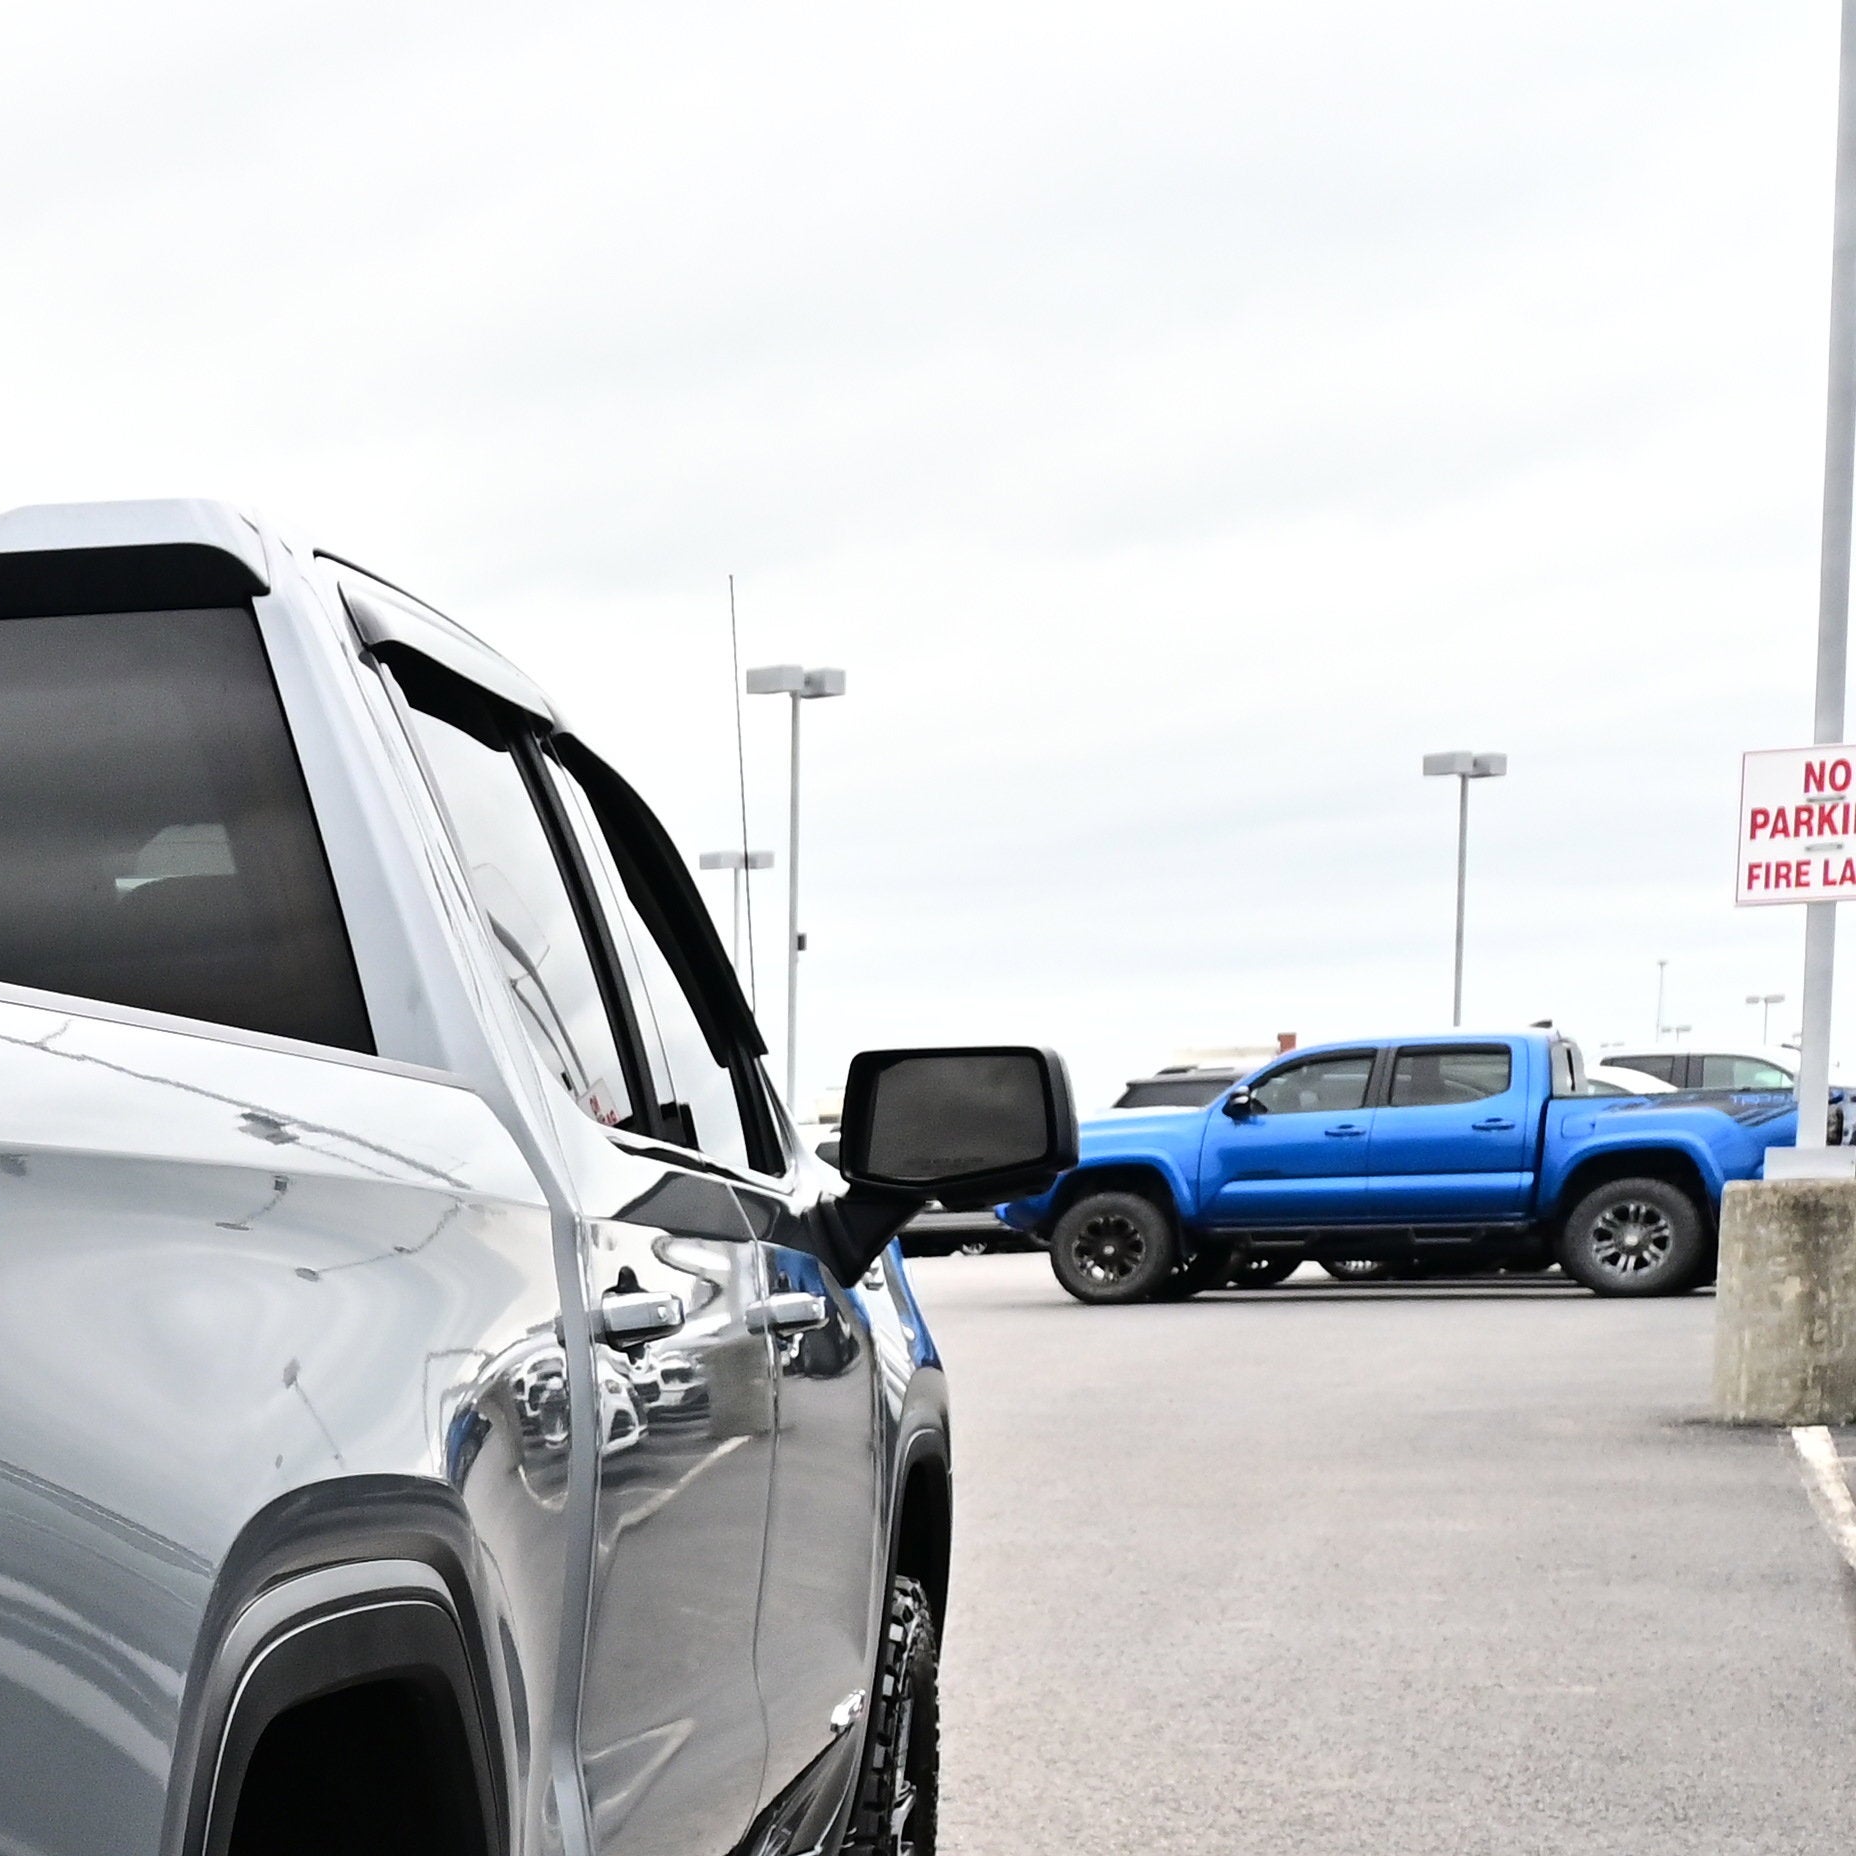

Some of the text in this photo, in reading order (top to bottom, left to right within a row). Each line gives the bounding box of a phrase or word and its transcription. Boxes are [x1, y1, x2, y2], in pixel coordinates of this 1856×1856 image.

[1804, 759, 1852, 793] NO
[1749, 802, 1856, 840] PARKI
[1747, 859, 1812, 890] FIRE
